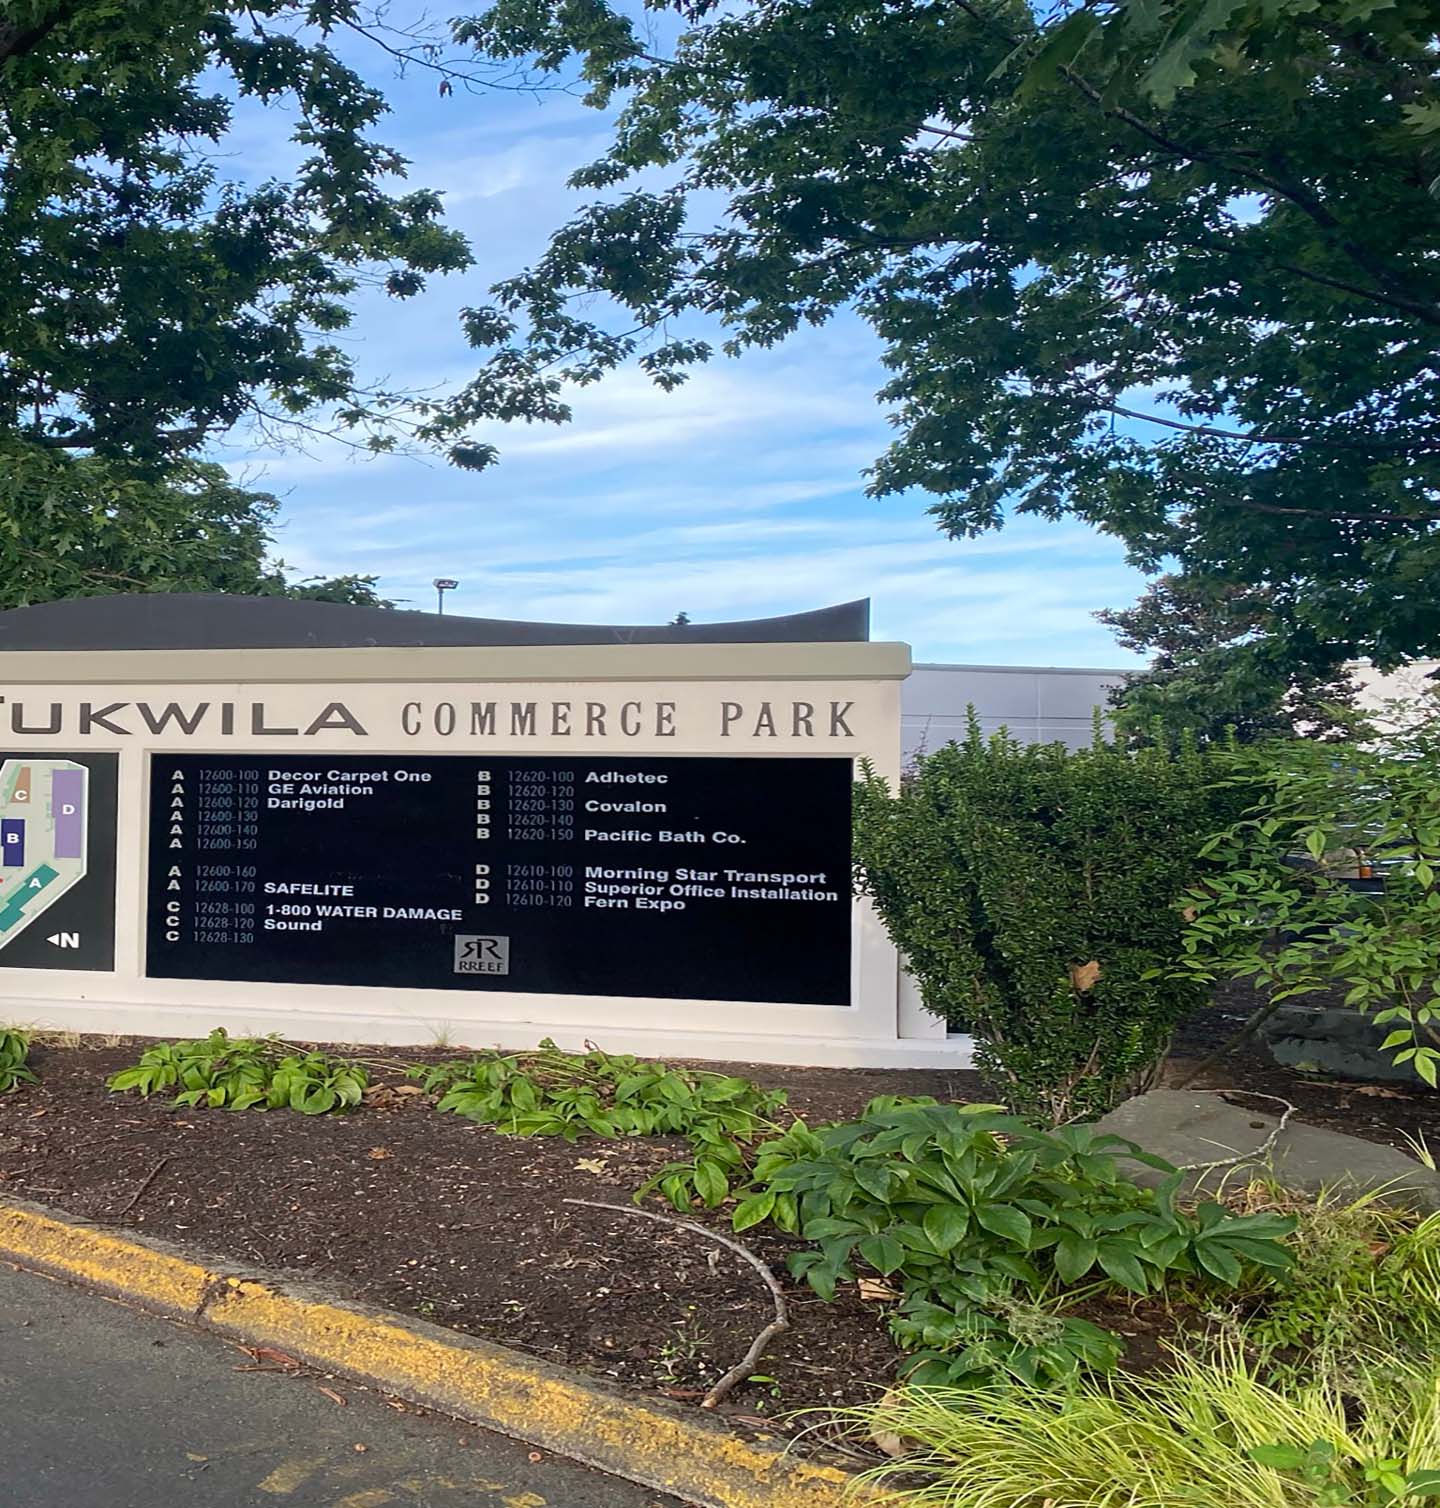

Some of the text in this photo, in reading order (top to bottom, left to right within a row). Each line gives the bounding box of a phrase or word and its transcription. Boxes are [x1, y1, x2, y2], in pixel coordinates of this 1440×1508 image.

[401, 702, 677, 736] COMMERCE
[720, 702, 856, 737] PARK
[171, 770, 432, 784] A 12600-100 Decor Carpet One
[478, 770, 669, 784] B 12620-100 Adhetec
[15, 790, 27, 800] C
[171, 784, 374, 795] A 12600-110 GE Aviation
[477, 785, 575, 797] B 12620-120
[62, 804, 75, 815] D
[170, 797, 345, 812] A 12600-120 Darigold
[477, 799, 667, 813] B 12620-130 Covalon
[169, 811, 258, 821] A 12600-130
[477, 814, 490, 825] B
[169, 824, 258, 835] A 12600-140
[476, 828, 747, 844] B 12620-150 Pacific Bath Co.
[7, 833, 19, 844] B
[168, 838, 257, 849] A 12600-150
[168, 865, 257, 878] A 12600-160
[475, 864, 827, 886] D 12610-100 Morning Star Transport
[29, 878, 42, 889] A
[167, 879, 355, 897] A 12600-170 SAFELITE
[475, 878, 839, 902] D 12610-110 Superior Office Installation
[475, 892, 686, 912] D 12610-120 Fern Expo
[166, 901, 463, 921] C 12628-100 1-800 WATER DAMAGE
[165, 915, 323, 931] C 12628-120 Sound
[61, 932, 79, 949] N
[165, 930, 255, 944] C 12628-130
[459, 960, 504, 973] RREEF
